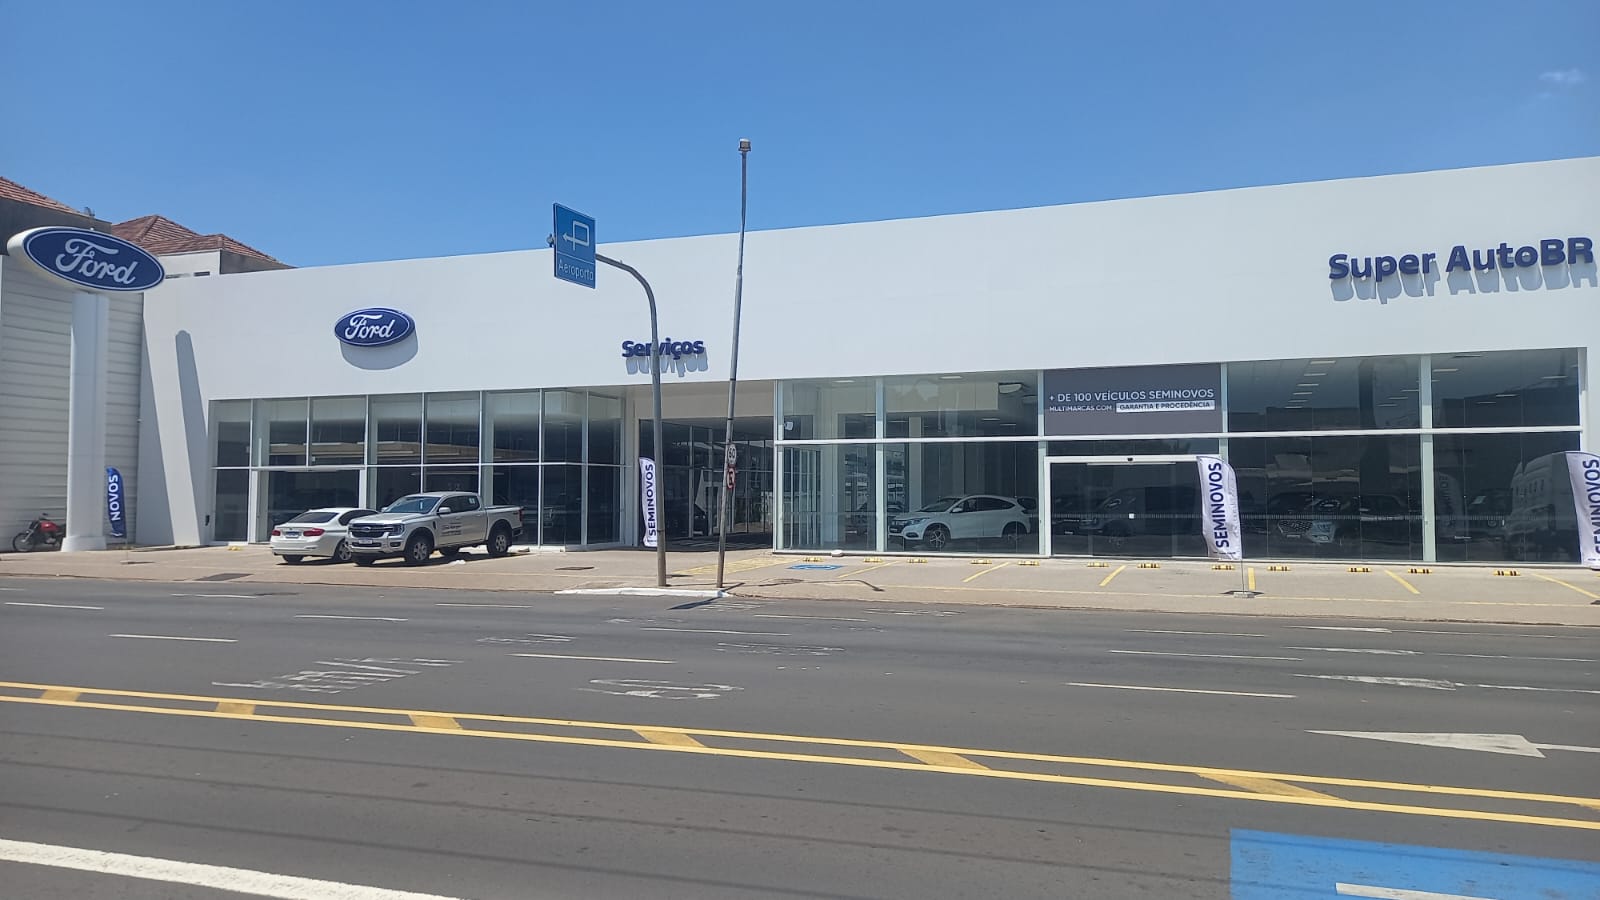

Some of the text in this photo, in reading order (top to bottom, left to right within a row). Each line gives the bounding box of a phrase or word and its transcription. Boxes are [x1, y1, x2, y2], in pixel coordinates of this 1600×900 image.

[55, 238, 138, 284] Ford
[558, 259, 594, 280] Aeroporto
[1329, 237, 1593, 282] Super AutoBR
[345, 314, 395, 339] Ford
[1057, 393, 1071, 402] DE
[1074, 393, 1092, 401] 100
[1094, 390, 1146, 401] VEÍCULOS
[1149, 389, 1214, 400] SEMINOVOS
[1119, 403, 1154, 411] GARANTIA
[1160, 401, 1210, 410] PROCEDÊNCIA
[108, 474, 121, 521] NOVOS
[645, 463, 657, 536] SEMINOVOS
[1208, 462, 1230, 548] SEMINOVOS
